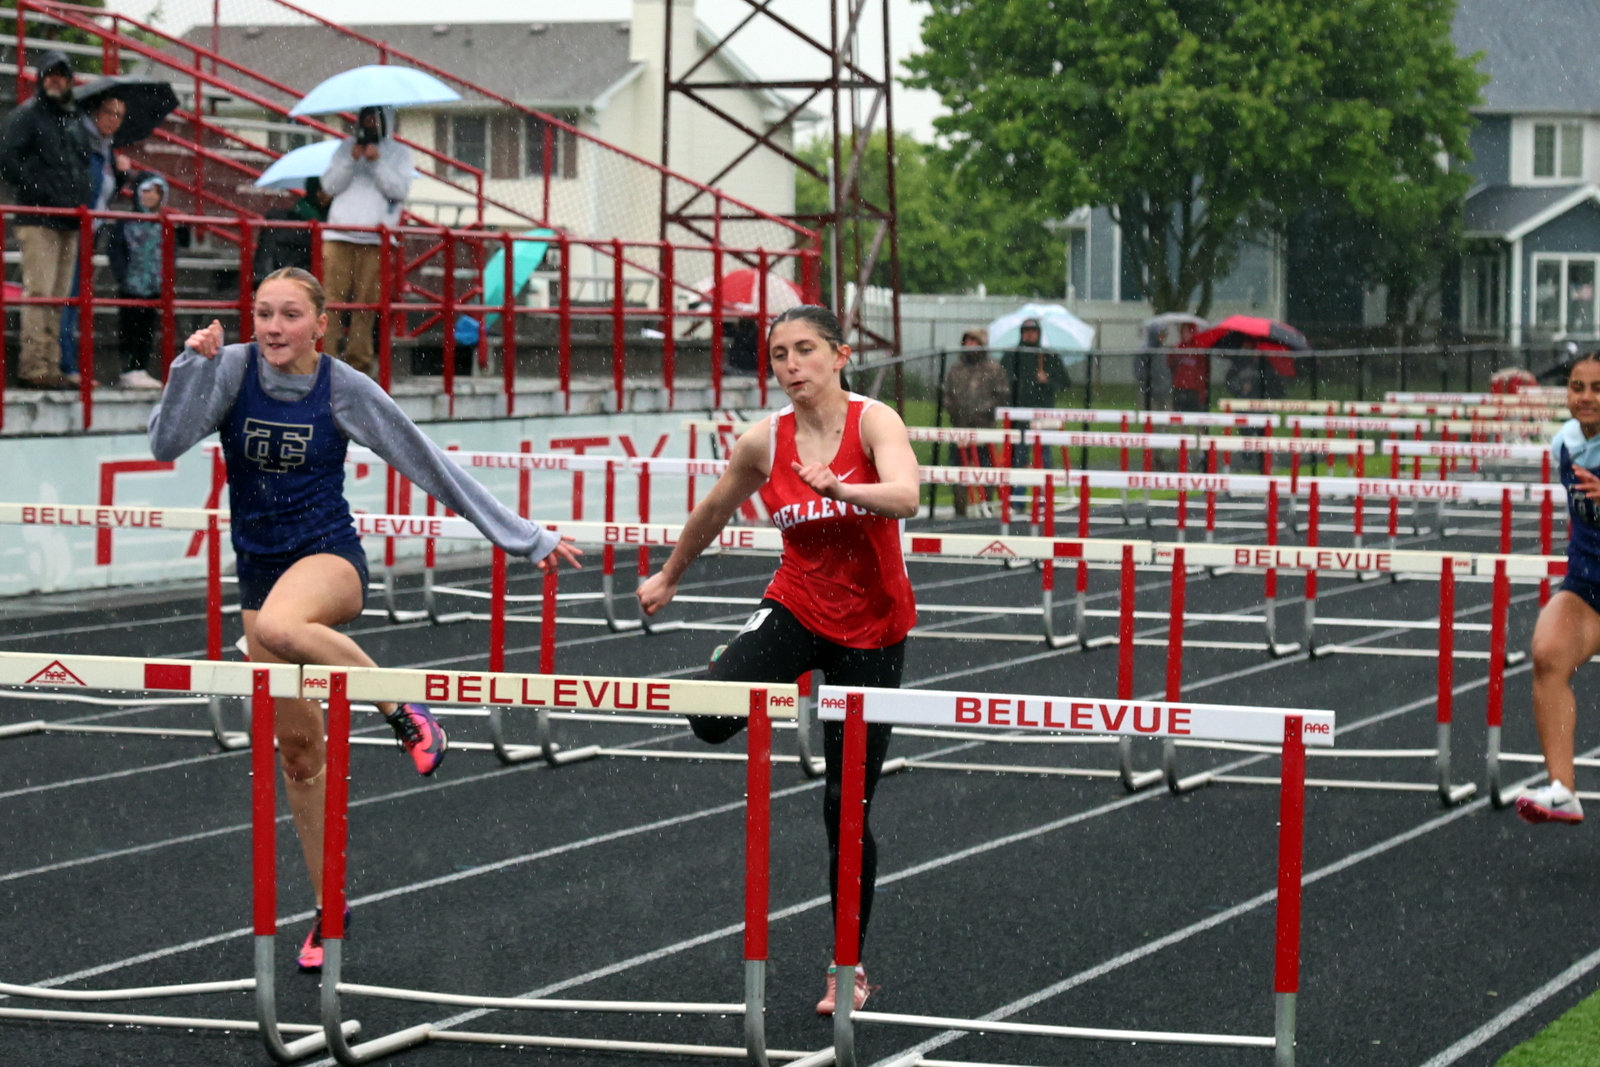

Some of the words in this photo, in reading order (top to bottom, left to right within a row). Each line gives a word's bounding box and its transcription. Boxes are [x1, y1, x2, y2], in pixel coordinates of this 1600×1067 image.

[1070, 434, 1150, 448] BELLEVUE
[1243, 438, 1331, 453] BELLEVUE
[1430, 444, 1510, 459] BELLEVUE
[472, 454, 569, 470] BELLEVUE
[918, 469, 1010, 485] ELLEVUE
[1128, 475, 1229, 491] BELLEVUE
[1357, 482, 1462, 499] BELLEVUE
[22, 506, 164, 528] BELLEVUE
[1234, 548, 1392, 573] BELLEVUE
[425, 673, 671, 711] BELLEVUE
[955, 697, 1192, 735] BELLEVUE
